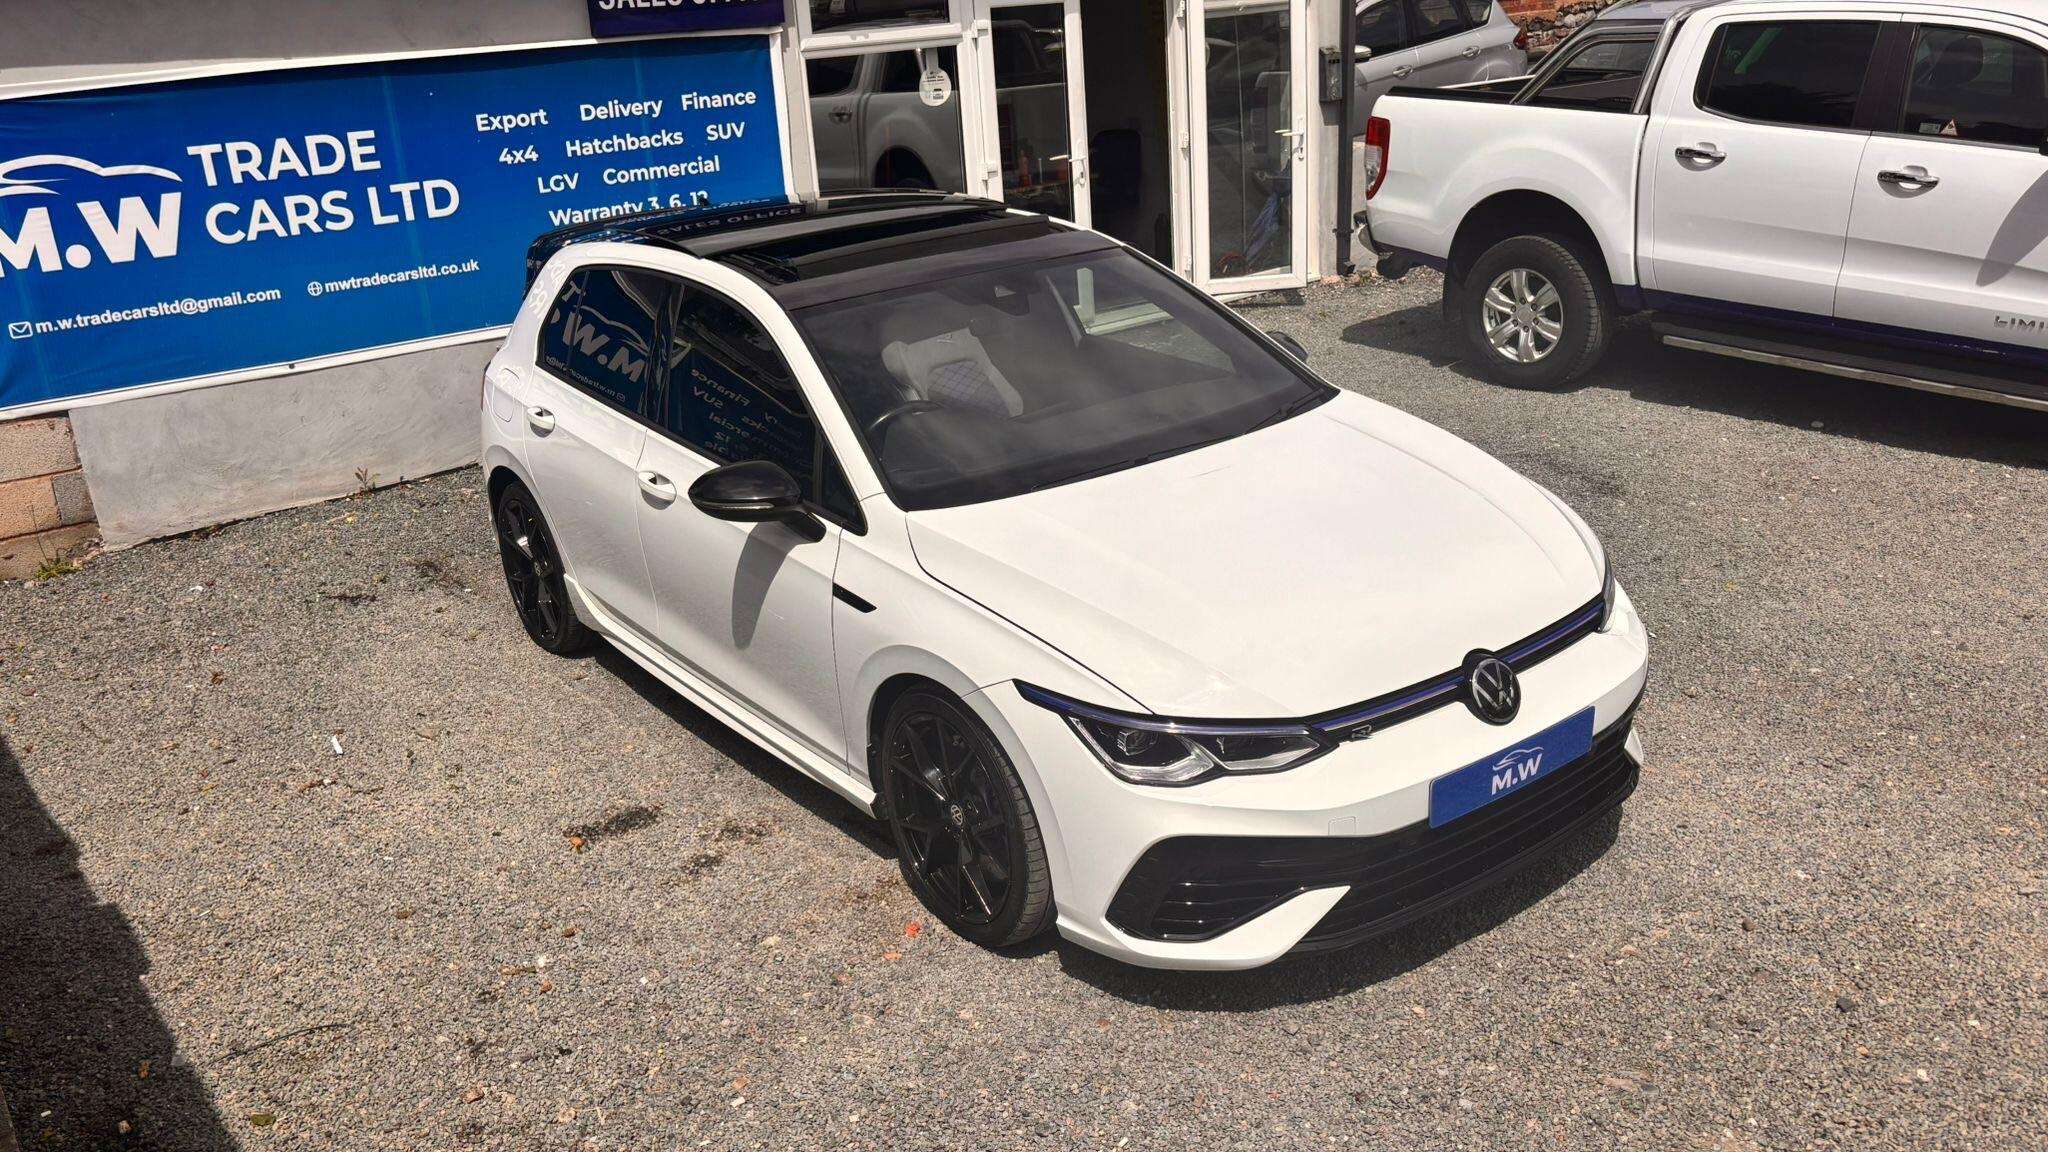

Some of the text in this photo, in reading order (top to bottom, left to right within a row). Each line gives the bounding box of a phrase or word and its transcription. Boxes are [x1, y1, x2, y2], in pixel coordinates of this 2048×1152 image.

[476, 90, 757, 133] Export Delivery Finance
[186, 129, 382, 188] TRADE
[498, 121, 746, 165] 4x4 Hatchbacks SUV
[537, 155, 721, 195] LGV Commercial
[204, 178, 460, 245] CARS LTD
[0, 192, 182, 278] M.W
[324, 258, 480, 293] mwtradecarsltd.co.uk
[35, 287, 282, 334] m.w.tradecarsltd@gmail.com
[1491, 754, 1543, 795] M.W
